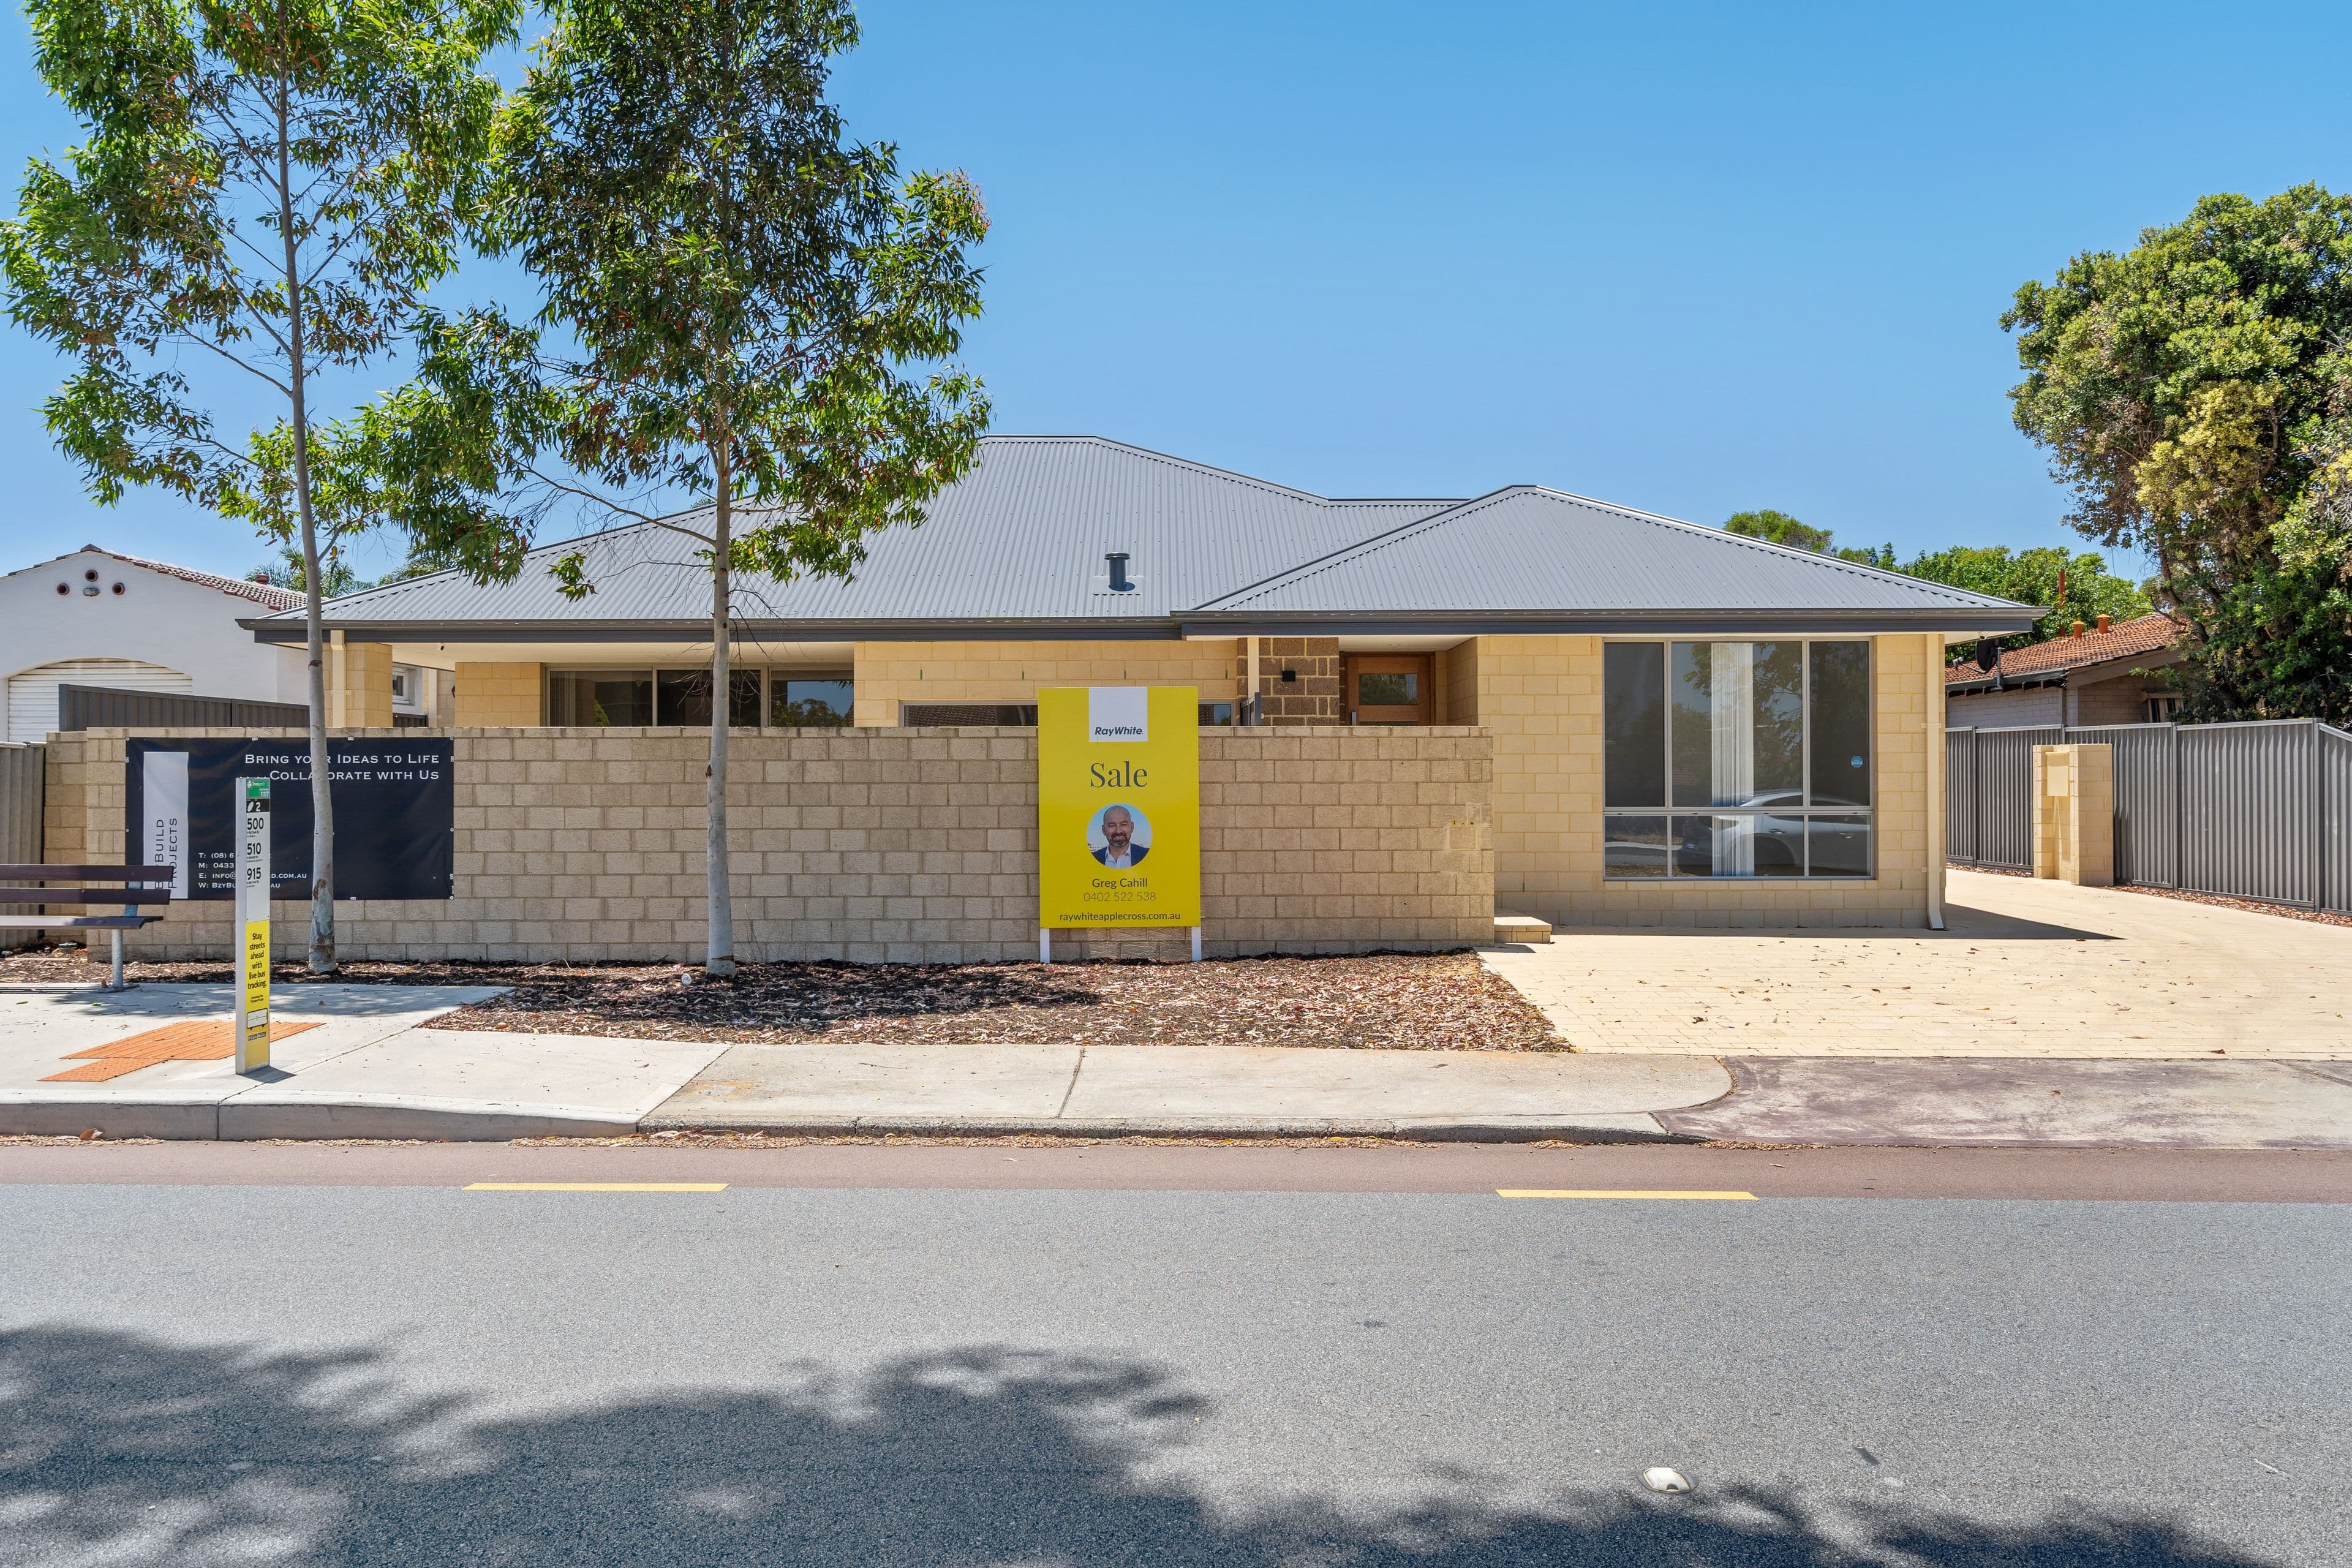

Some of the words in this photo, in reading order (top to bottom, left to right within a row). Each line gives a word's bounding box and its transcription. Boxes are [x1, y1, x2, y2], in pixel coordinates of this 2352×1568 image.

[245, 754, 289, 764] BRING
[294, 755, 331, 764] YOR
[337, 754, 379, 764] IDEAS
[384, 755, 402, 764] TO
[408, 753, 439, 764] LIFE
[270, 770, 371, 780] COLLAORATE
[419, 770, 439, 780] US
[1090, 761, 1148, 788] Sale
[255, 802, 261, 812] 2
[247, 817, 264, 830] 500
[247, 842, 262, 855] 510
[247, 867, 261, 880] 915
[1092, 878, 1117, 889] Greg
[1120, 878, 1148, 888] Cahill
[1084, 892, 1110, 902] 0402
[1114, 892, 1133, 902] 522
[1137, 892, 1156, 902] 538
[1060, 912, 1181, 922] raywhiteapplecross.com.au
[250, 950, 264, 960] ahead
